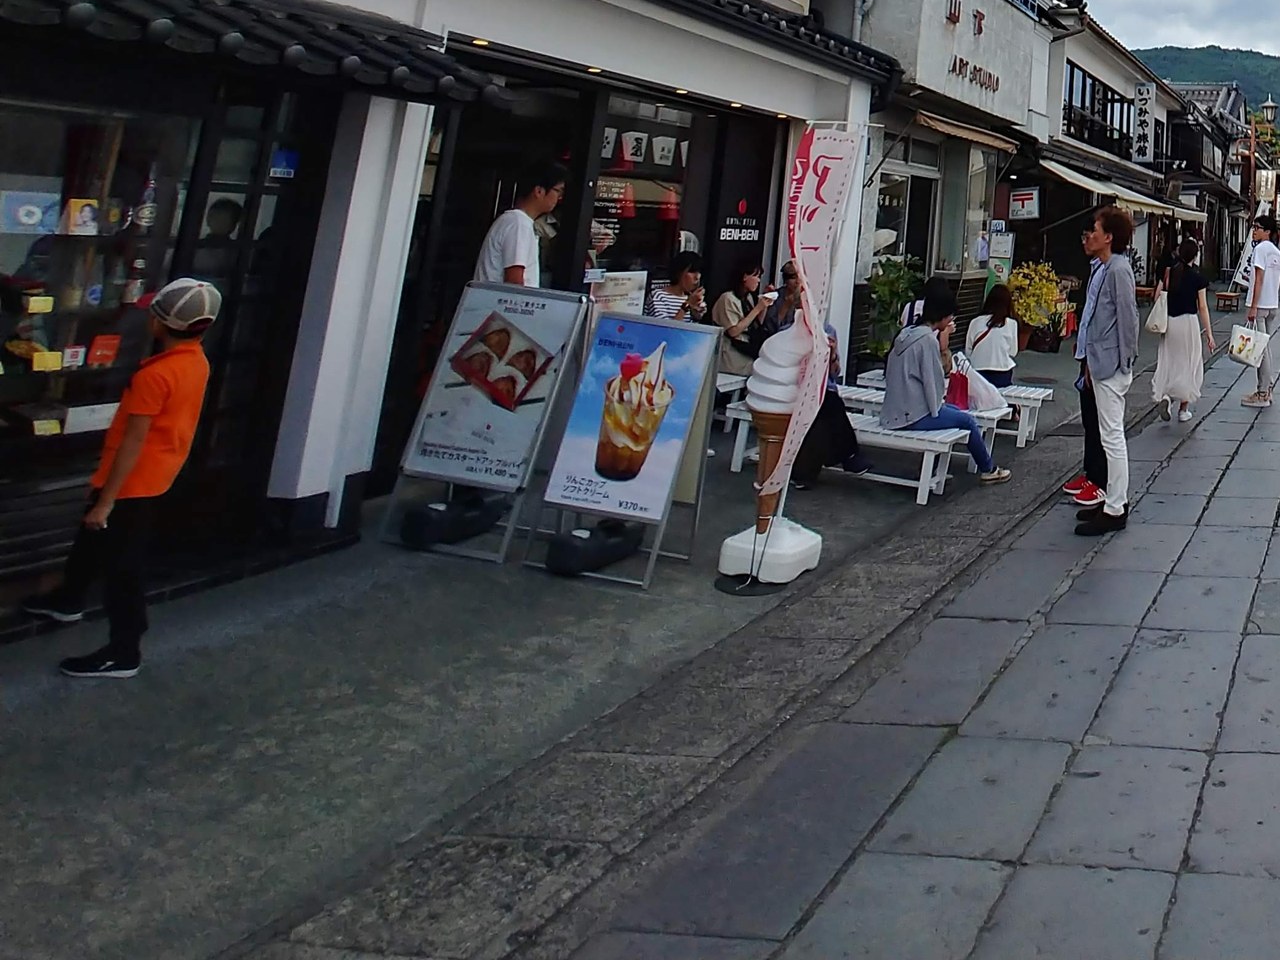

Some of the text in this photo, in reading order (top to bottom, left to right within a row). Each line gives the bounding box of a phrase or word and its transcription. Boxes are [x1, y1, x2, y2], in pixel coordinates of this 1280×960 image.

[948, 54, 1000, 93] ART STUDIO
[1135, 87, 1151, 158] いづみや旅館
[720, 227, 760, 241] BENI-BENI
[566, 474, 607, 489] りんごカップ
[562, 485, 610, 500] ソフトクリーム
